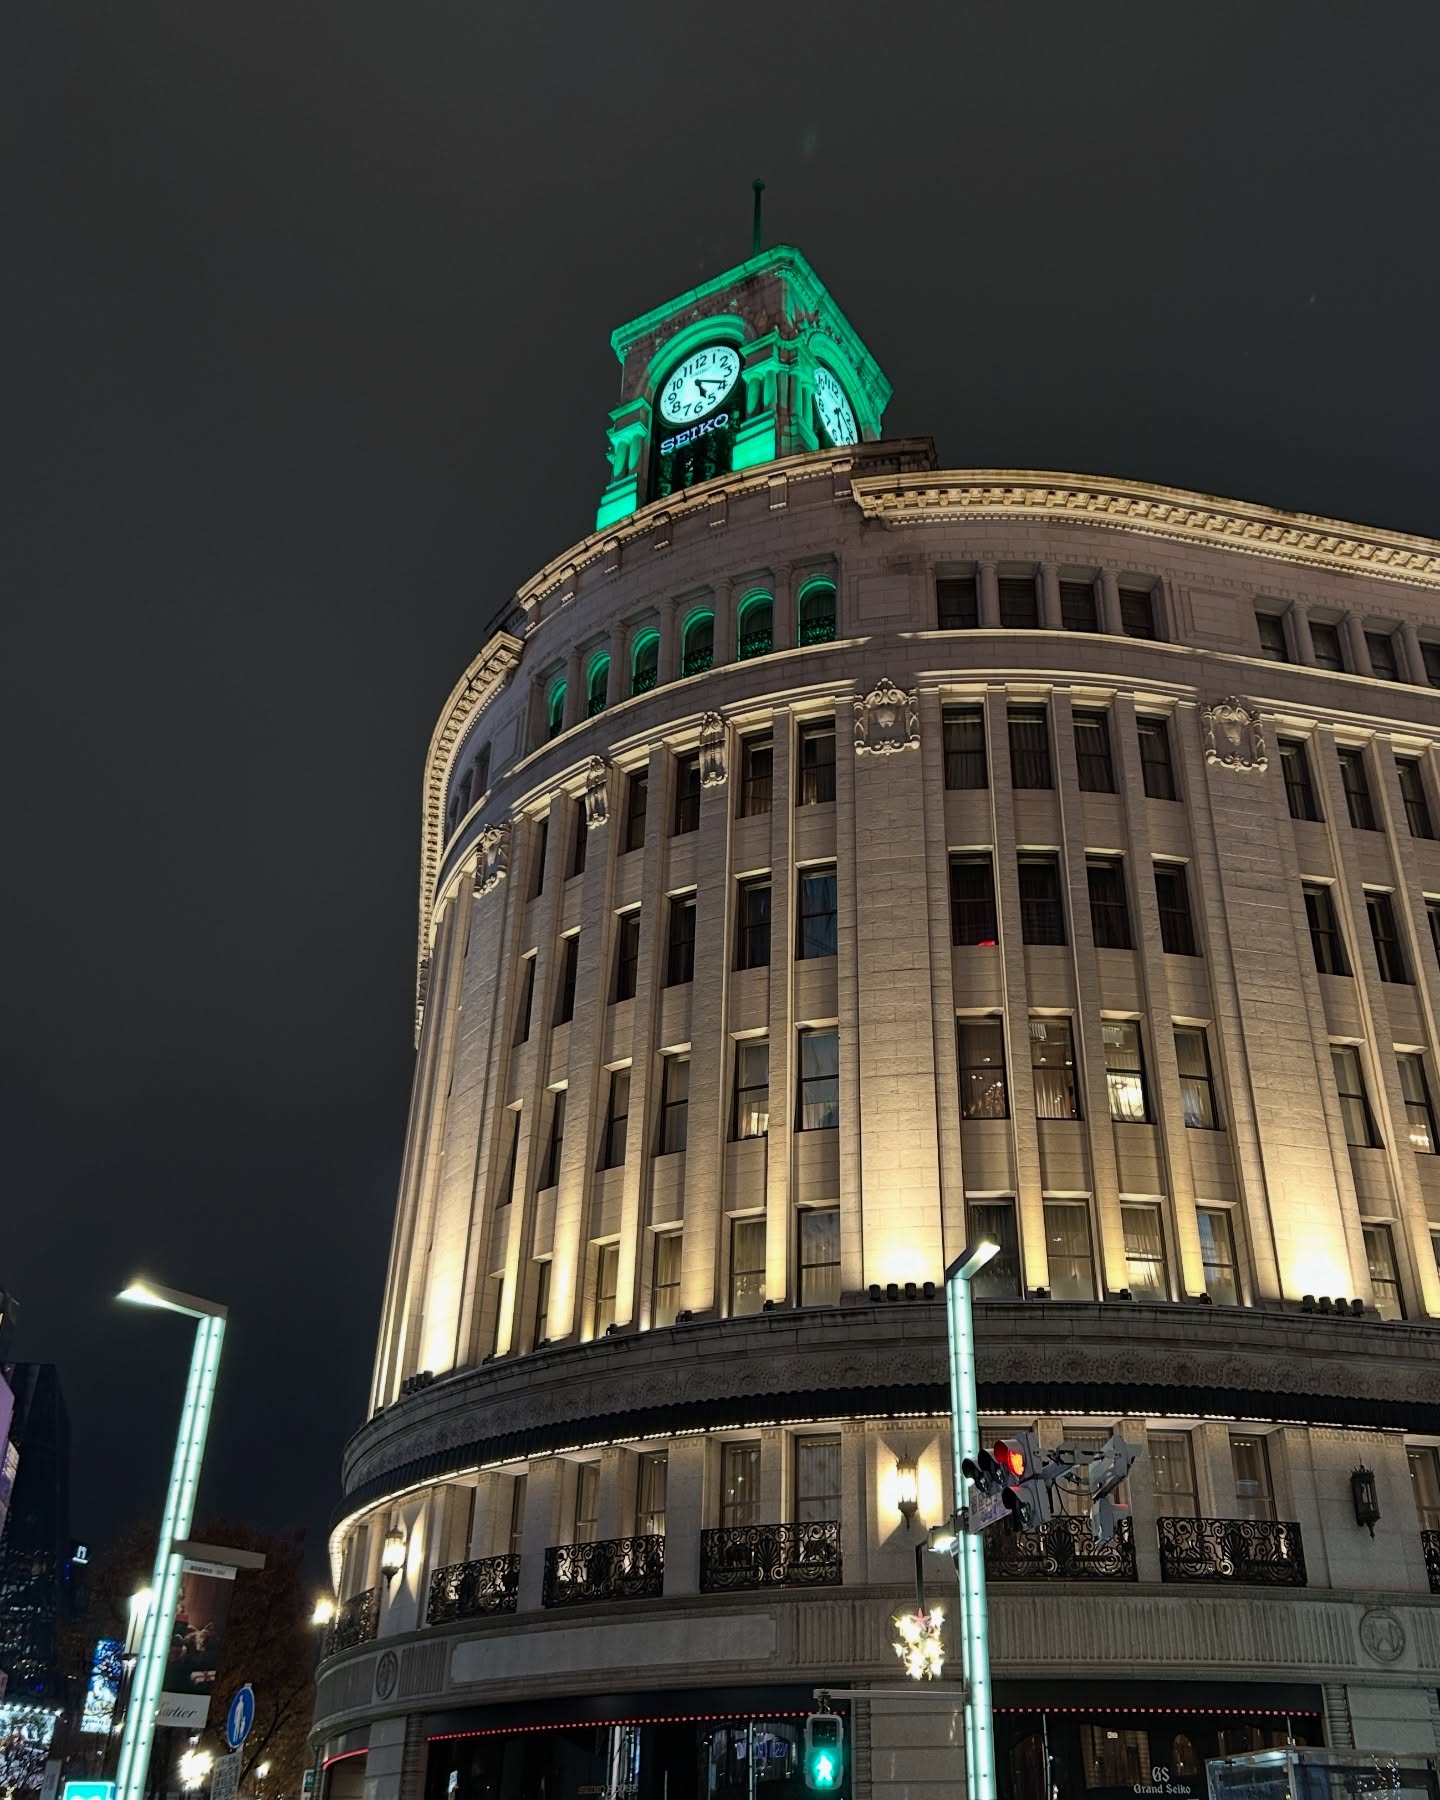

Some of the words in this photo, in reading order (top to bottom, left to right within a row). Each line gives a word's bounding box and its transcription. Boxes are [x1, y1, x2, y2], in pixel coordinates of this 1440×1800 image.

[695, 355, 707, 369] 12
[713, 353, 716, 364] 1
[720, 355, 728, 369] 2
[683, 364, 692, 377] 11
[723, 364, 732, 378] 3
[673, 378, 683, 391] 10
[668, 392, 677, 405] 9
[707, 393, 716, 405] 5
[671, 401, 681, 413] 8
[683, 403, 692, 416] 7
[693, 401, 703, 414] 6
[661, 414, 729, 456] SEIKO
[1152, 1766, 1170, 1782] GS
[1133, 1783, 1164, 1794] Grand
[1166, 1783, 1191, 1795] Seiko
